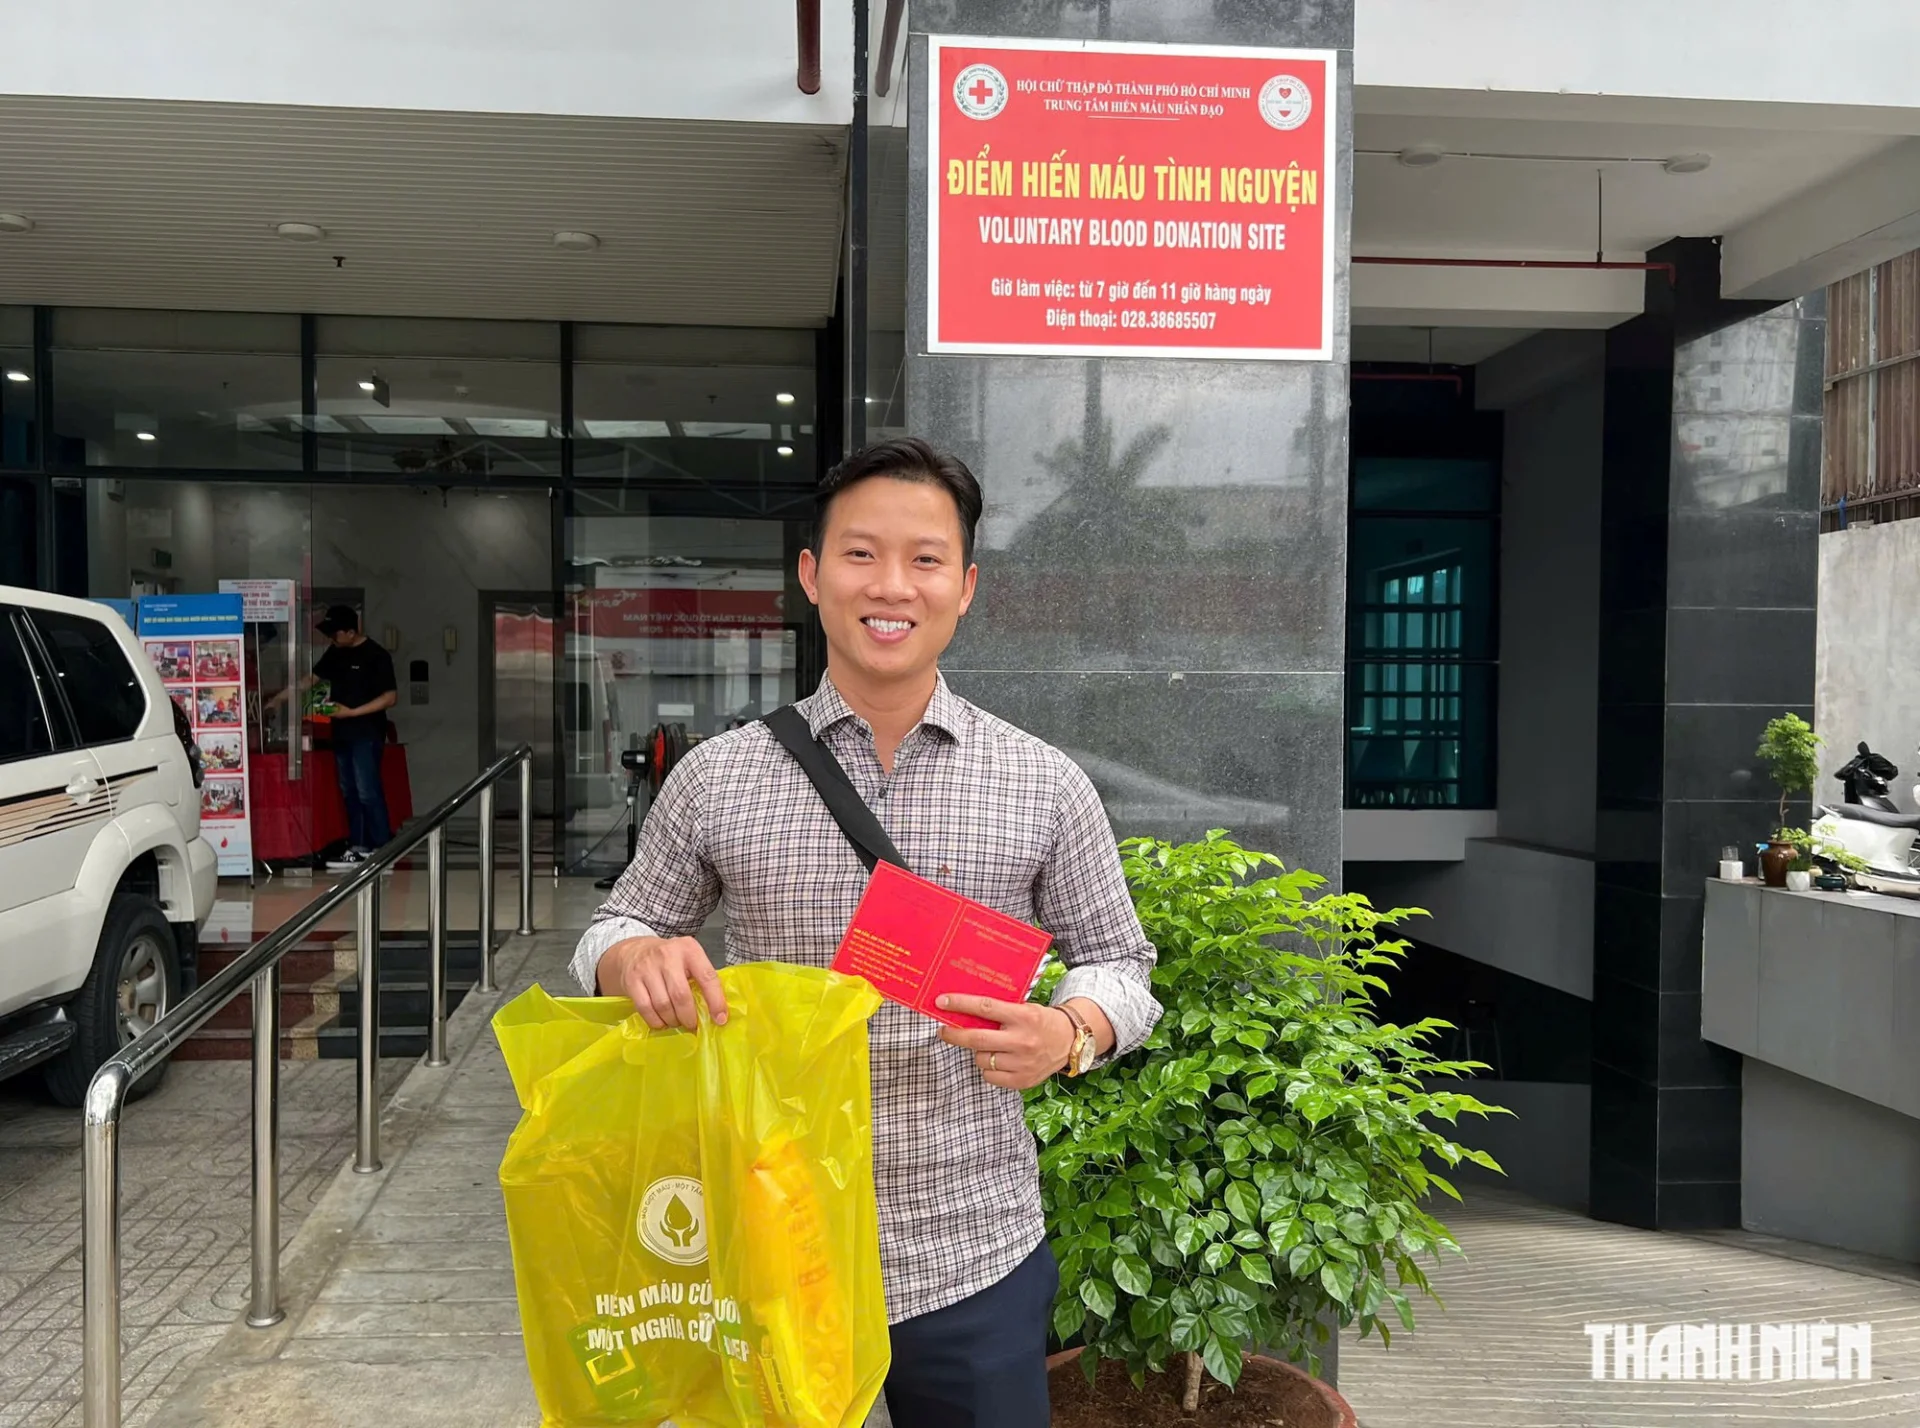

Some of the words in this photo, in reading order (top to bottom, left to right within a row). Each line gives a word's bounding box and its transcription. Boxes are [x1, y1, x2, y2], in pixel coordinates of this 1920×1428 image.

[1016, 78, 1037, 94] HỘI
[1039, 78, 1065, 93] CHỮ
[1066, 80, 1095, 96] THẬP
[1097, 80, 1113, 94] ĐỎ
[1115, 80, 1153, 96] THÀNH
[1199, 83, 1219, 98] CHÍ
[1221, 86, 1251, 99] MINH
[1044, 98, 1082, 112] TRUNG
[1200, 104, 1224, 119] ĐẠO
[946, 143, 1013, 197] ĐIỂM
[1022, 149, 1080, 198] HIẾN
[1090, 155, 1145, 201] MÁU
[1153, 156, 1212, 202] TÌNH
[1220, 160, 1318, 213] NGUYỆN
[978, 216, 1084, 246] VOLUNTARY
[1088, 219, 1148, 247] BLOOD
[1153, 221, 1242, 249] DONATION
[1248, 223, 1286, 250] SITE
[991, 278, 1013, 297] Giờ
[1016, 278, 1040, 297] làm
[1044, 279, 1075, 302] việc:
[1079, 280, 1094, 299] từ
[1097, 281, 1105, 298] 7
[1109, 281, 1129, 303] giờ
[1132, 279, 1157, 300] đến
[1161, 282, 1176, 300] 11
[1181, 282, 1201, 304] giờ
[1204, 283, 1237, 305] hàng
[1240, 283, 1272, 306] ngày
[1046, 308, 1076, 331] Điện
[1079, 309, 1117, 331] thoại:
[1120, 310, 1217, 330] 028.38685507
[639, 1279, 684, 1308] MÁU
[588, 1325, 625, 1355] MỘT
[630, 1314, 685, 1346] NGHĨA
